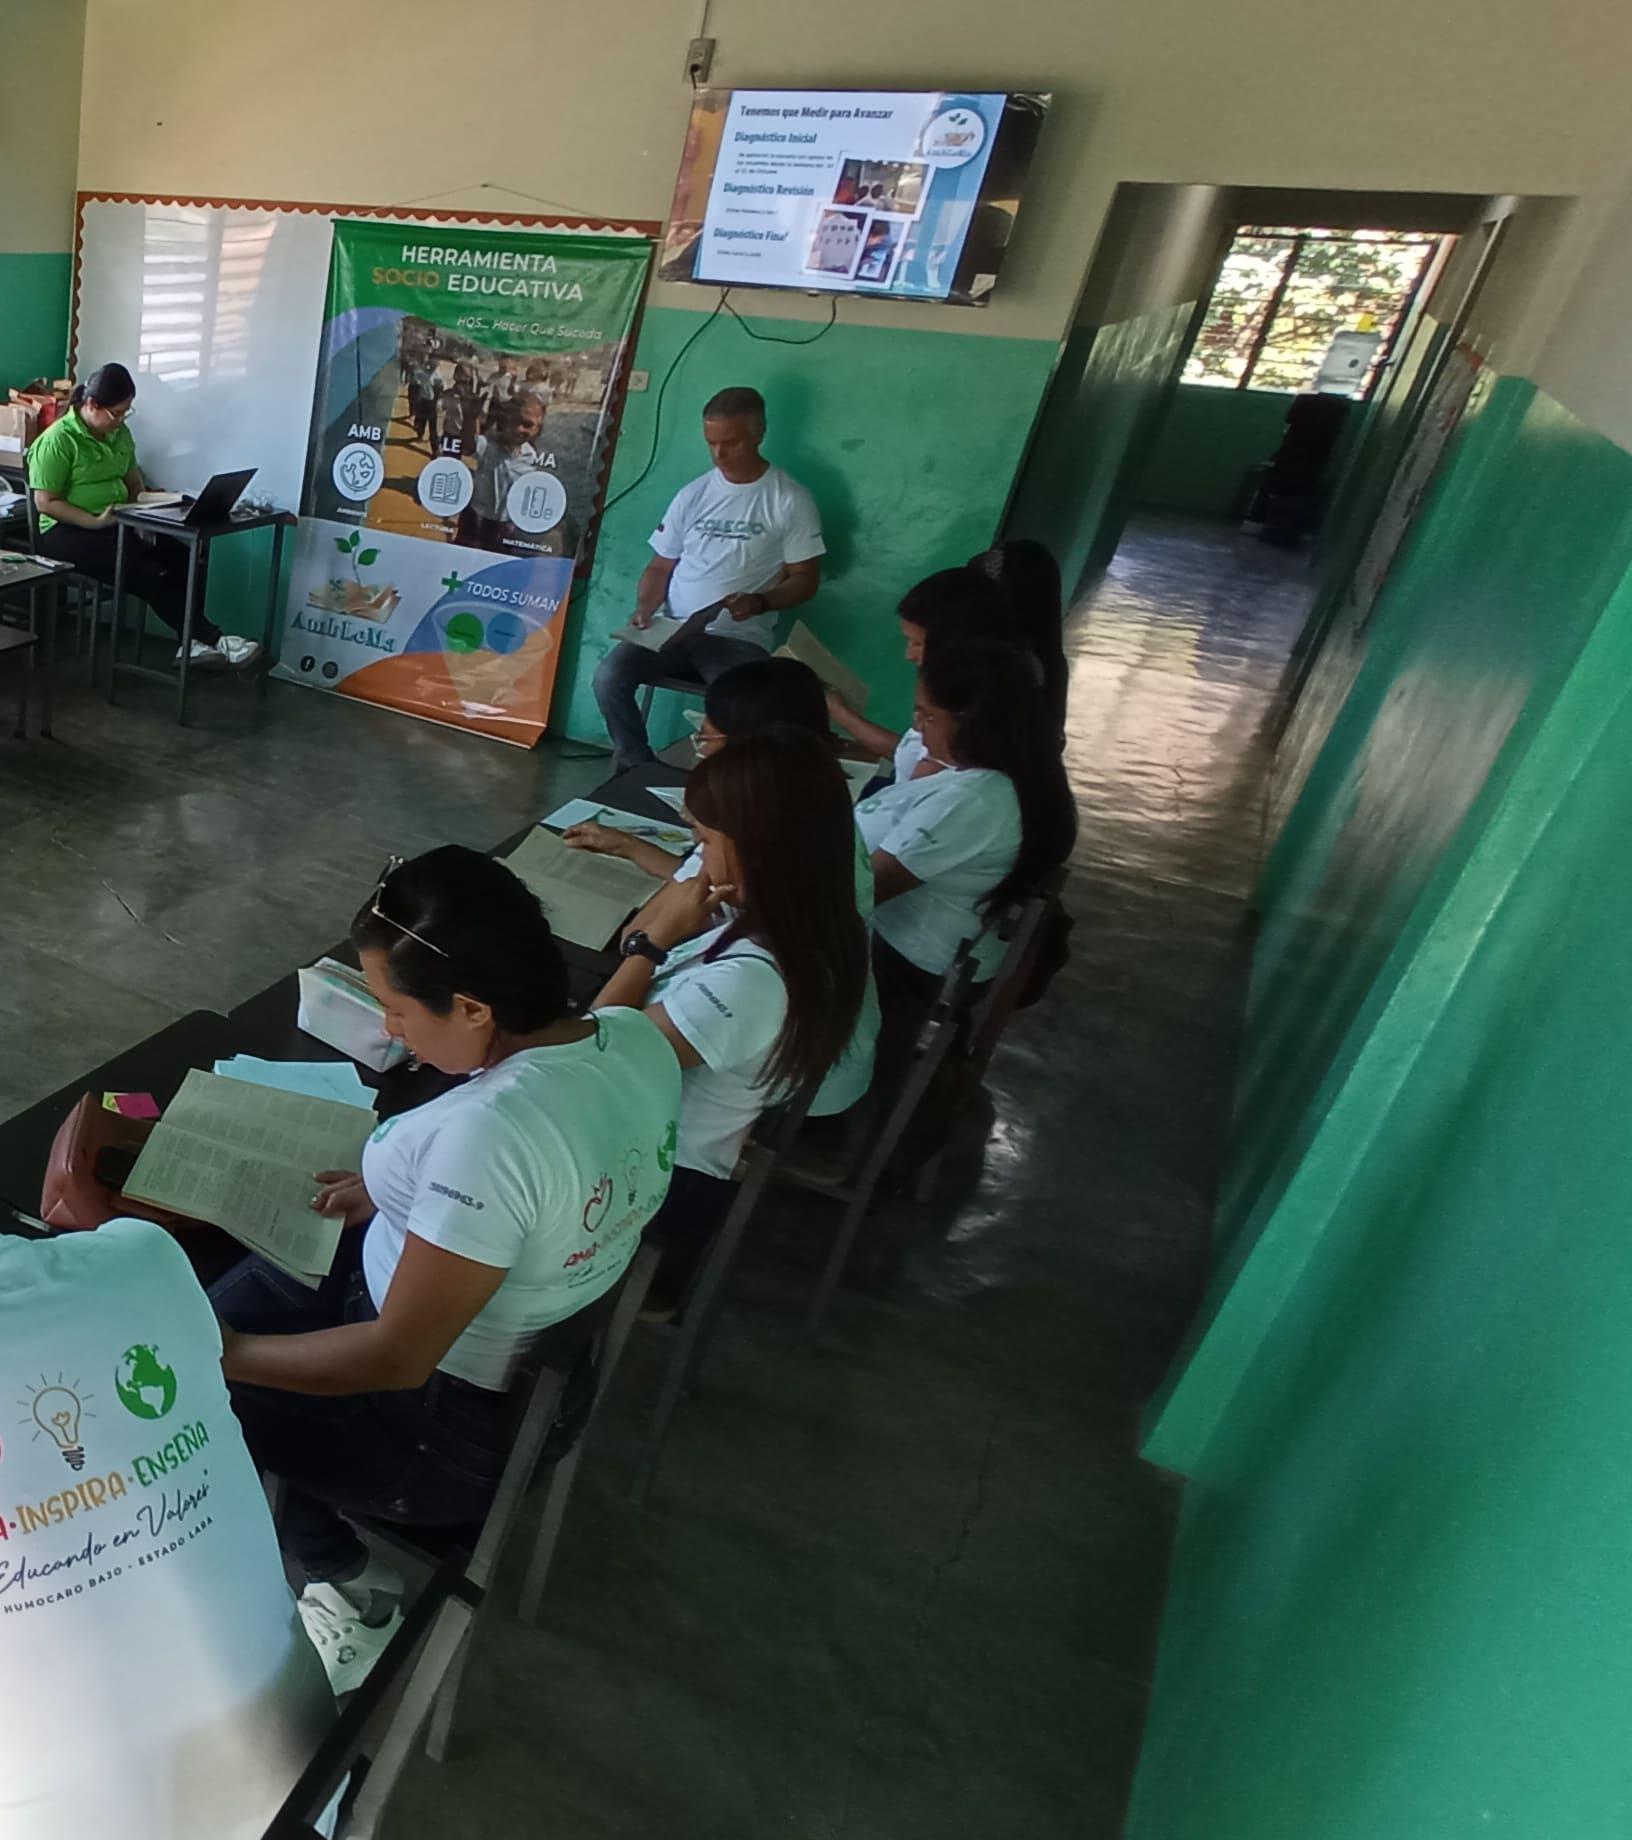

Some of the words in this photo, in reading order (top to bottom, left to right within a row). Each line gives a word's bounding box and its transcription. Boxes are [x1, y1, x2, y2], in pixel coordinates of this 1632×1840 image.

[740, 105, 780, 117] Tenemos
[782, 108, 799, 120] que
[801, 106, 828, 118] Medir
[829, 107, 852, 120] para
[853, 106, 894, 119] Avanzar
[788, 132, 817, 144] Inicial
[401, 245, 557, 273] HERRAMIENTA
[372, 267, 440, 288] SOCIO
[447, 274, 583, 302] EDUCATIVA
[530, 322, 555, 335] Que
[348, 423, 381, 440] AMB
[442, 437, 462, 453] LE
[531, 452, 557, 468] MA
[467, 581, 510, 601] TODOS
[510, 591, 560, 612] SUMAN
[15, 1471, 128, 1535] INSPIRA
[132, 1421, 211, 1488] ENSEÑA
[112, 1528, 140, 1549] en
[4, 1583, 84, 1614] HUMOCARO
[89, 1566, 123, 1588] BAJO
[138, 1537, 186, 1567] ESTADO
[188, 1516, 214, 1541] LARA
